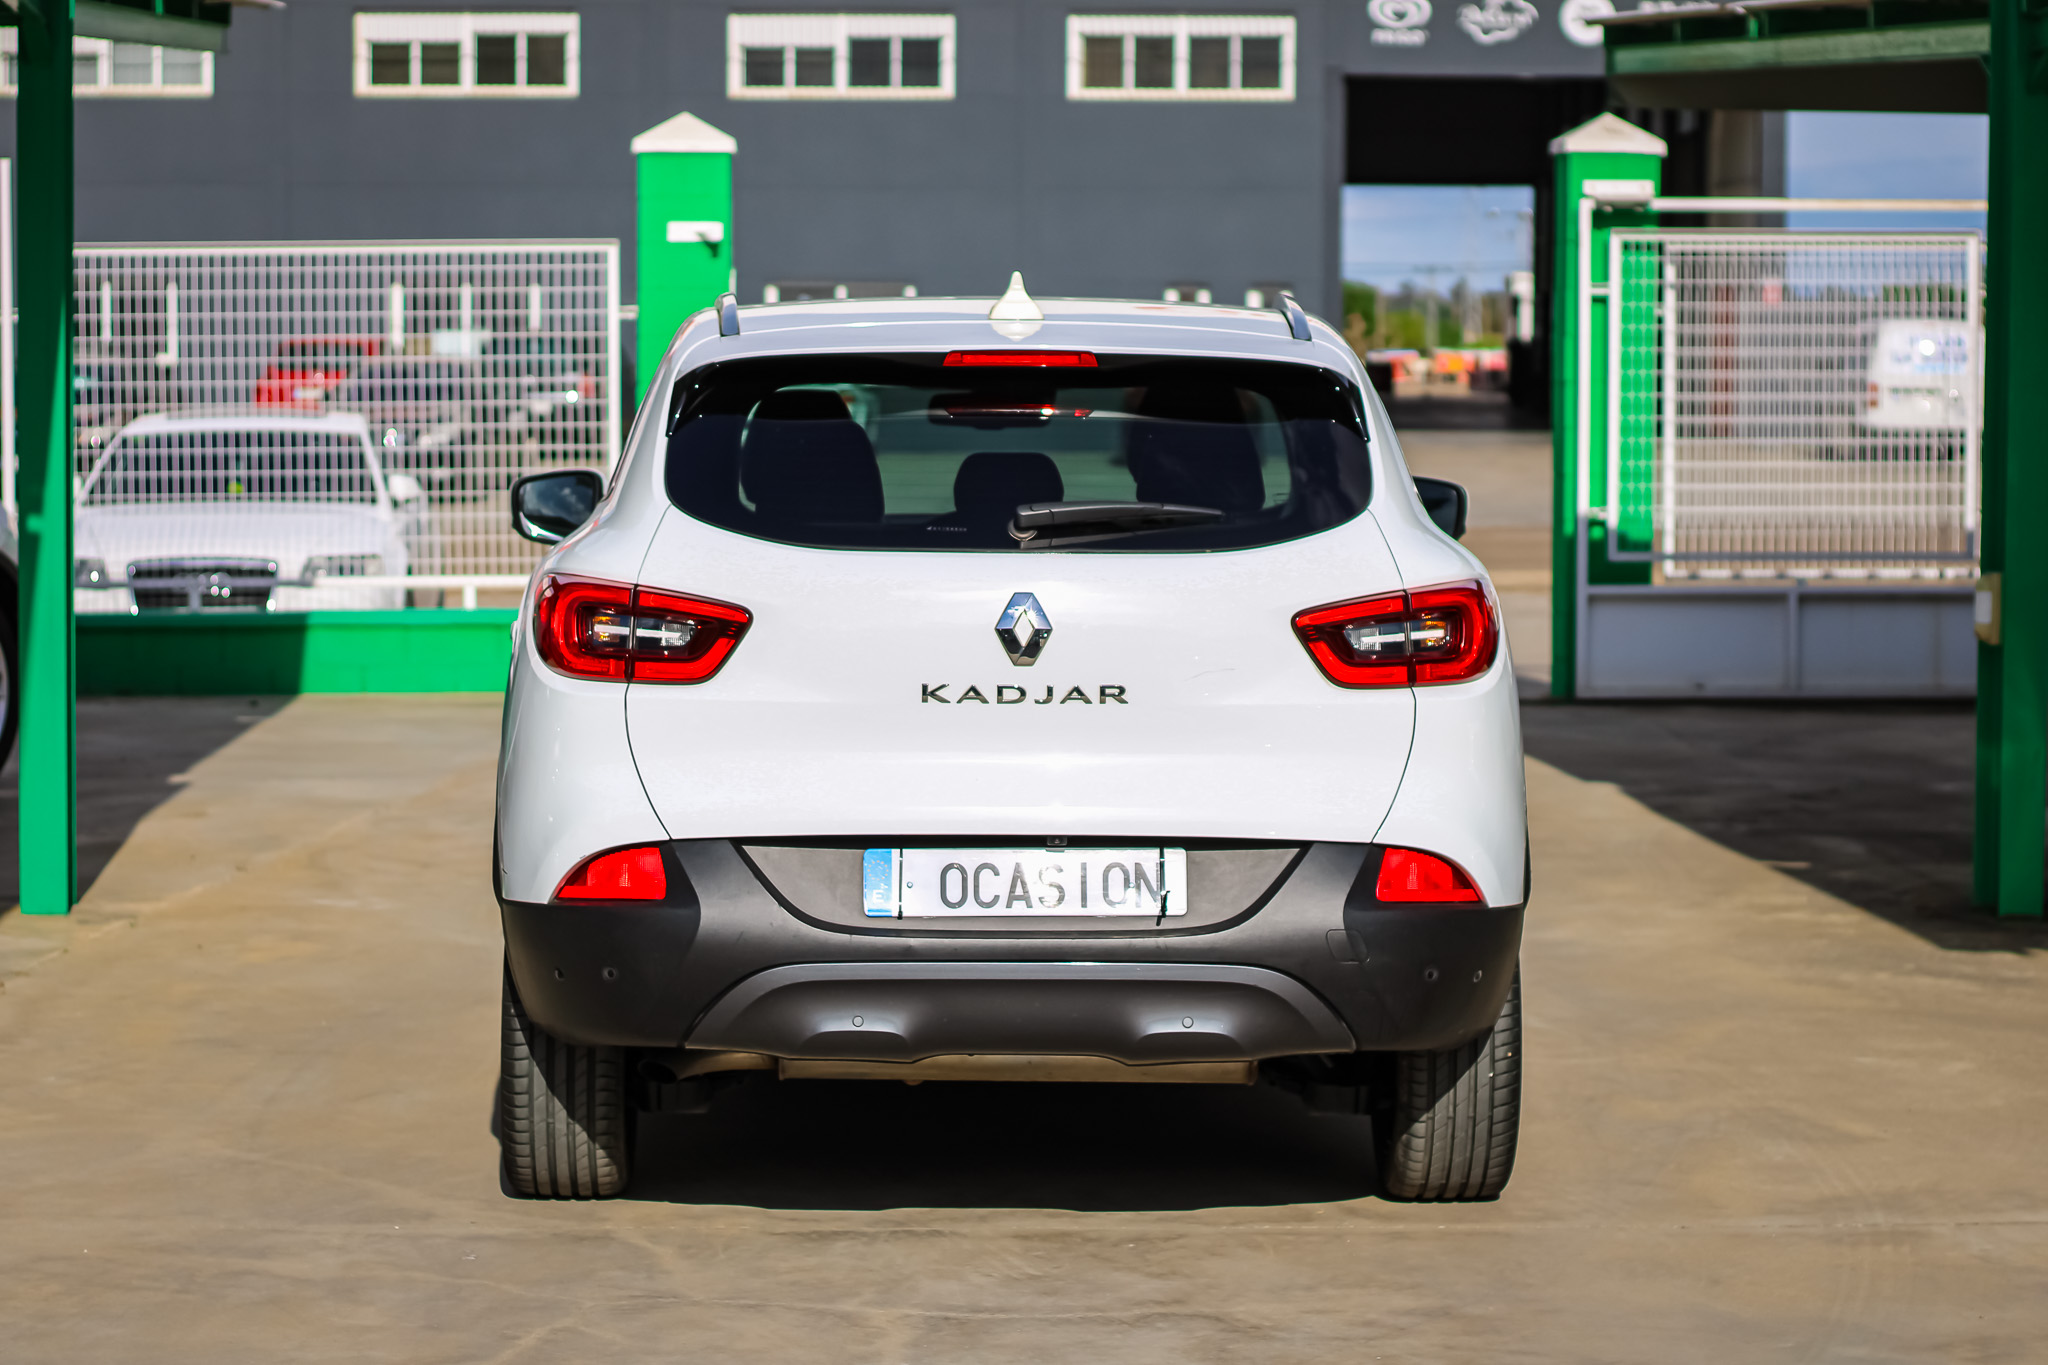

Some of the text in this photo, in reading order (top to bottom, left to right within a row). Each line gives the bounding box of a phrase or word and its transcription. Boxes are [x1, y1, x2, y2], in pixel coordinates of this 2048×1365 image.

[921, 683, 1129, 704] KADJAR
[940, 861, 1161, 909] OCASION
[872, 889, 885, 904] E
